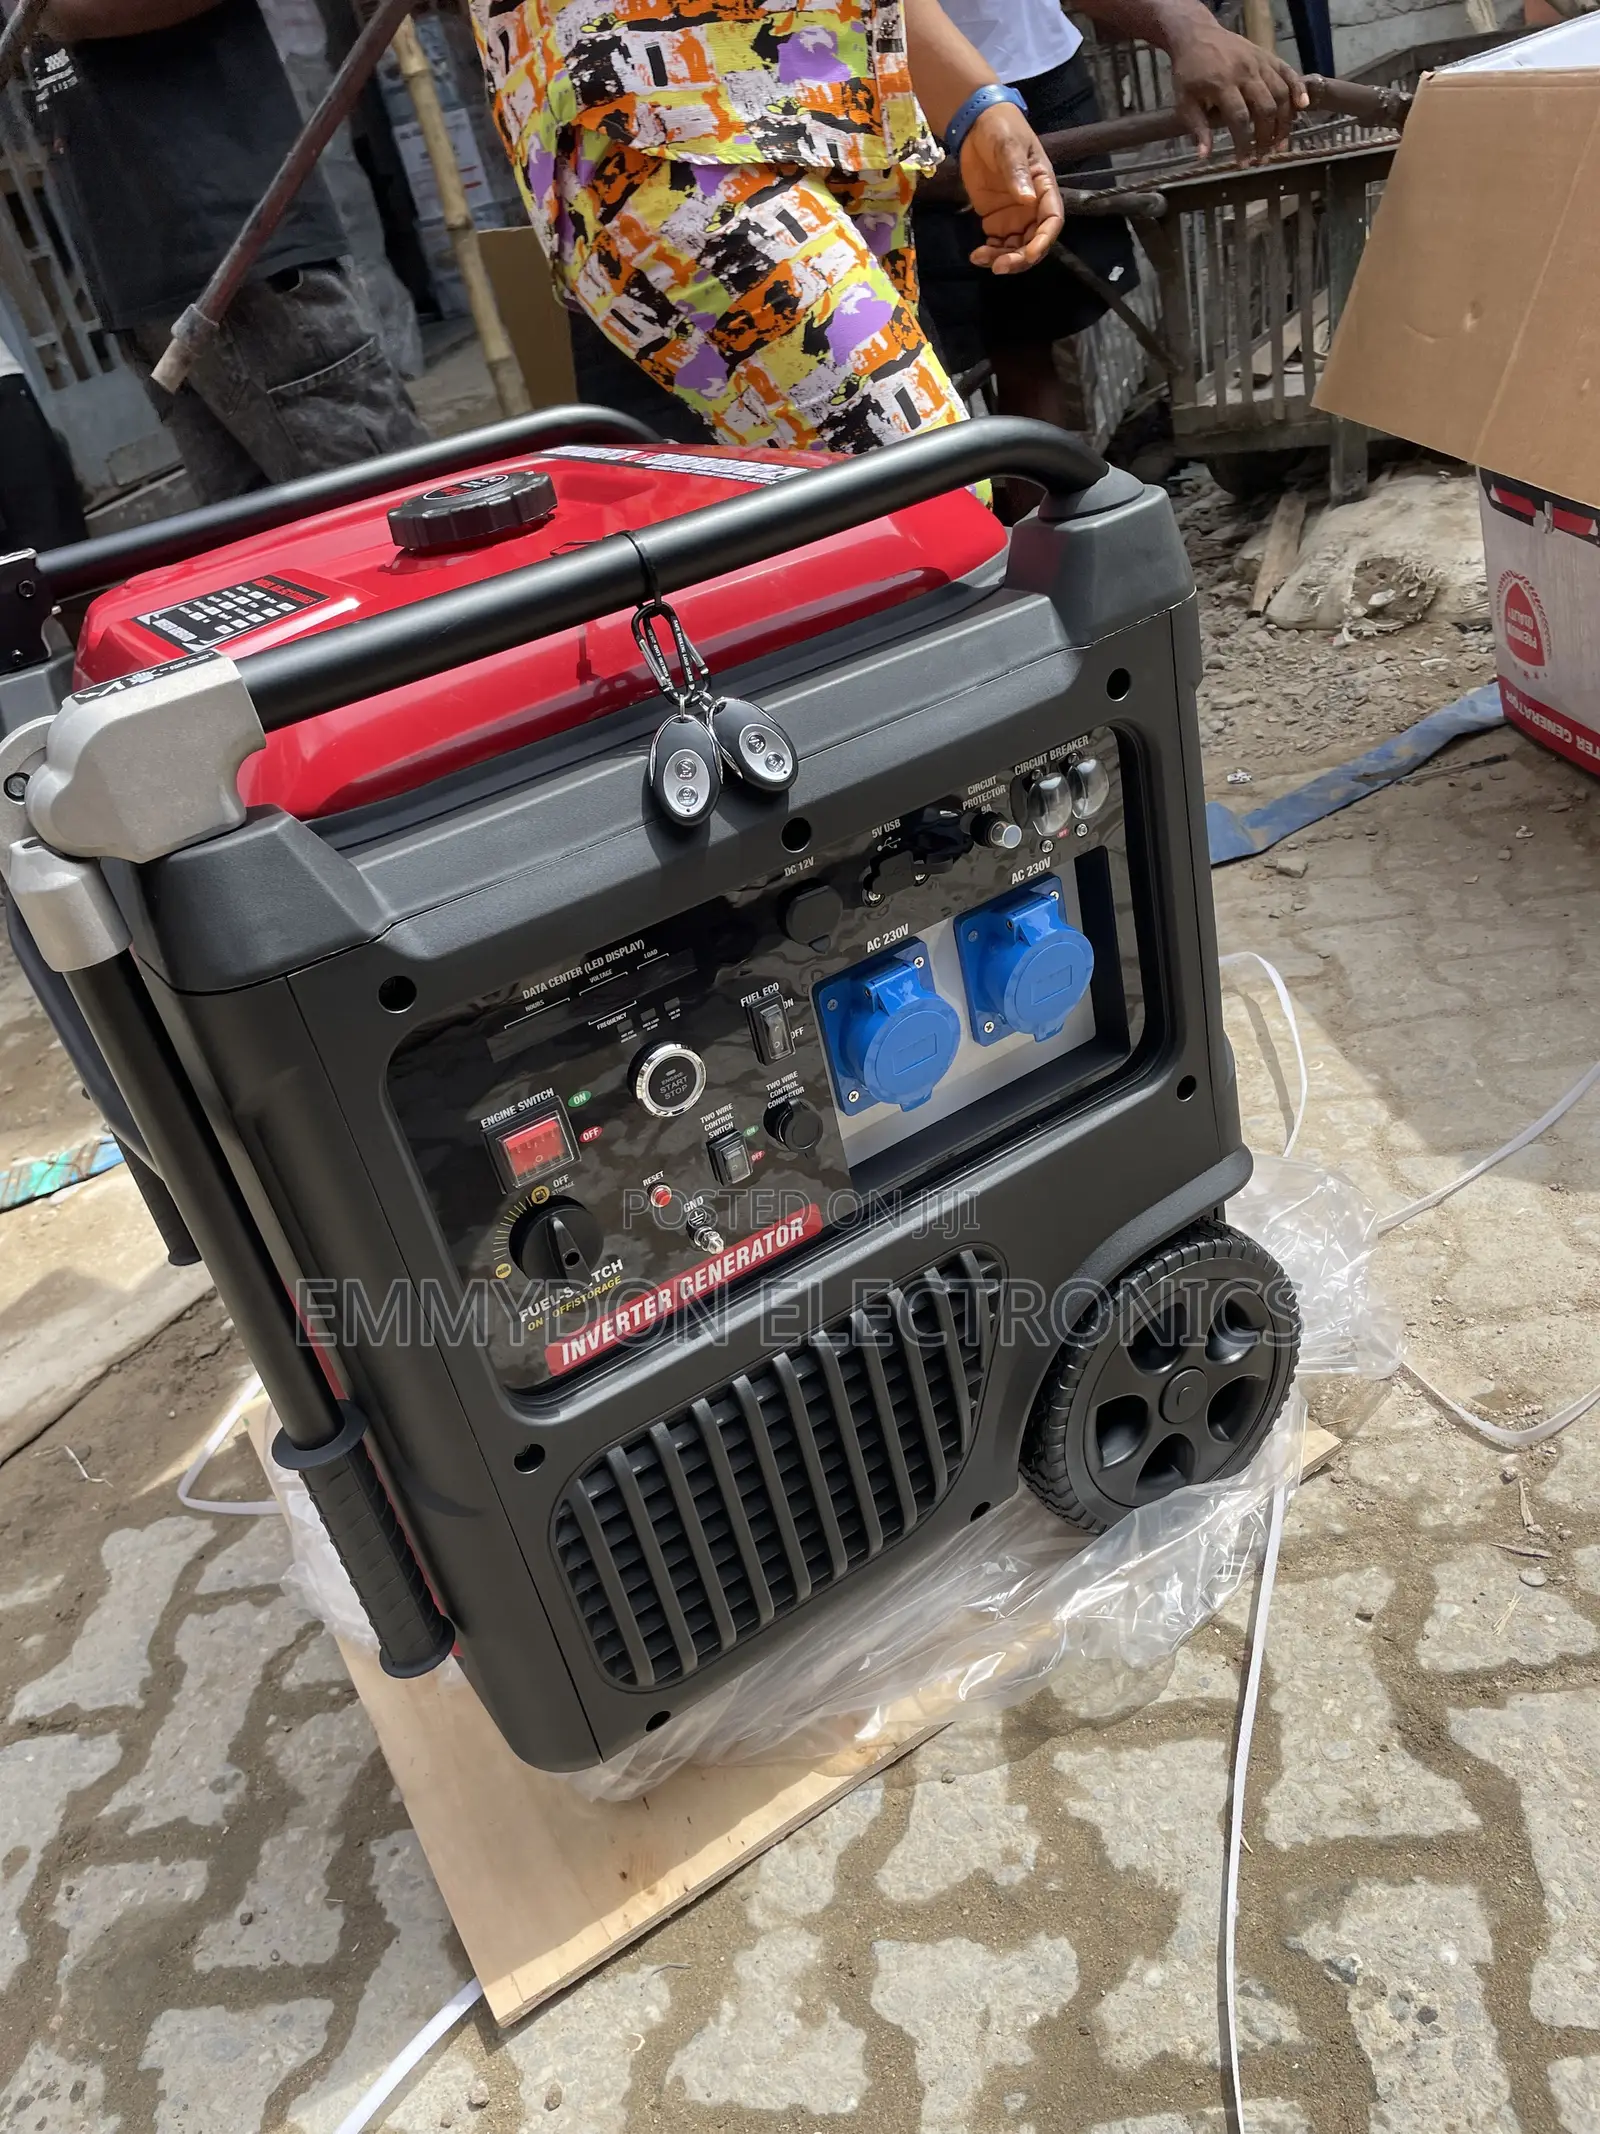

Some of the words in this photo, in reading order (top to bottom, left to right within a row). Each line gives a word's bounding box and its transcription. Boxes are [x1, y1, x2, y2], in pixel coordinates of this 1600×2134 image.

[1505, 690, 1572, 744] GENERATOR
[1014, 752, 1048, 776] CIRCUIT
[1050, 735, 1089, 761] BREAKER
[967, 775, 997, 795] CIRCUIT
[962, 784, 1006, 811] PROTECTOR
[871, 826, 883, 838] 5V
[883, 819, 901, 833] USB
[784, 864, 797, 877] DC
[798, 856, 814, 871] 12V
[1012, 869, 1026, 885] AC
[1027, 856, 1051, 877] 230V
[867, 936, 882, 953] AC
[884, 923, 909, 946] 230V
[522, 981, 548, 1000] DATA
[548, 967, 583, 989] CENTER
[584, 957, 605, 974] (LED
[604, 939, 645, 966] DISPLAY)
[740, 991, 761, 1007] FUEL
[762, 982, 780, 997] ECO
[783, 998, 794, 1010] ON
[596, 1012, 627, 1030] FREQUENCY
[790, 1026, 804, 1040] OFF
[660, 1075, 688, 1094] START
[766, 1080, 781, 1091] TWO
[781, 1070, 798, 1084] WIRE
[770, 1080, 799, 1099] CONTROL
[573, 1092, 588, 1105] ON
[664, 1084, 688, 1100] STOP
[480, 1105, 518, 1129] ENGINE
[518, 1088, 555, 1112] SWITCH
[700, 1112, 716, 1124] TWO
[716, 1103, 734, 1117] WIRE
[704, 1112, 734, 1132] CONTROL
[708, 1122, 734, 1139] SWITCH
[746, 1126, 756, 1136] ON
[582, 1127, 600, 1141] OFF
[553, 1174, 570, 1188] OFF
[642, 1170, 664, 1187] RESET
[683, 1196, 704, 1214] GND
[518, 1259, 624, 1323] FUEL-STCH
[562, 1288, 673, 1366] INVERTER
[679, 1216, 804, 1300] GENERATOR
[527, 1318, 544, 1332] ON
